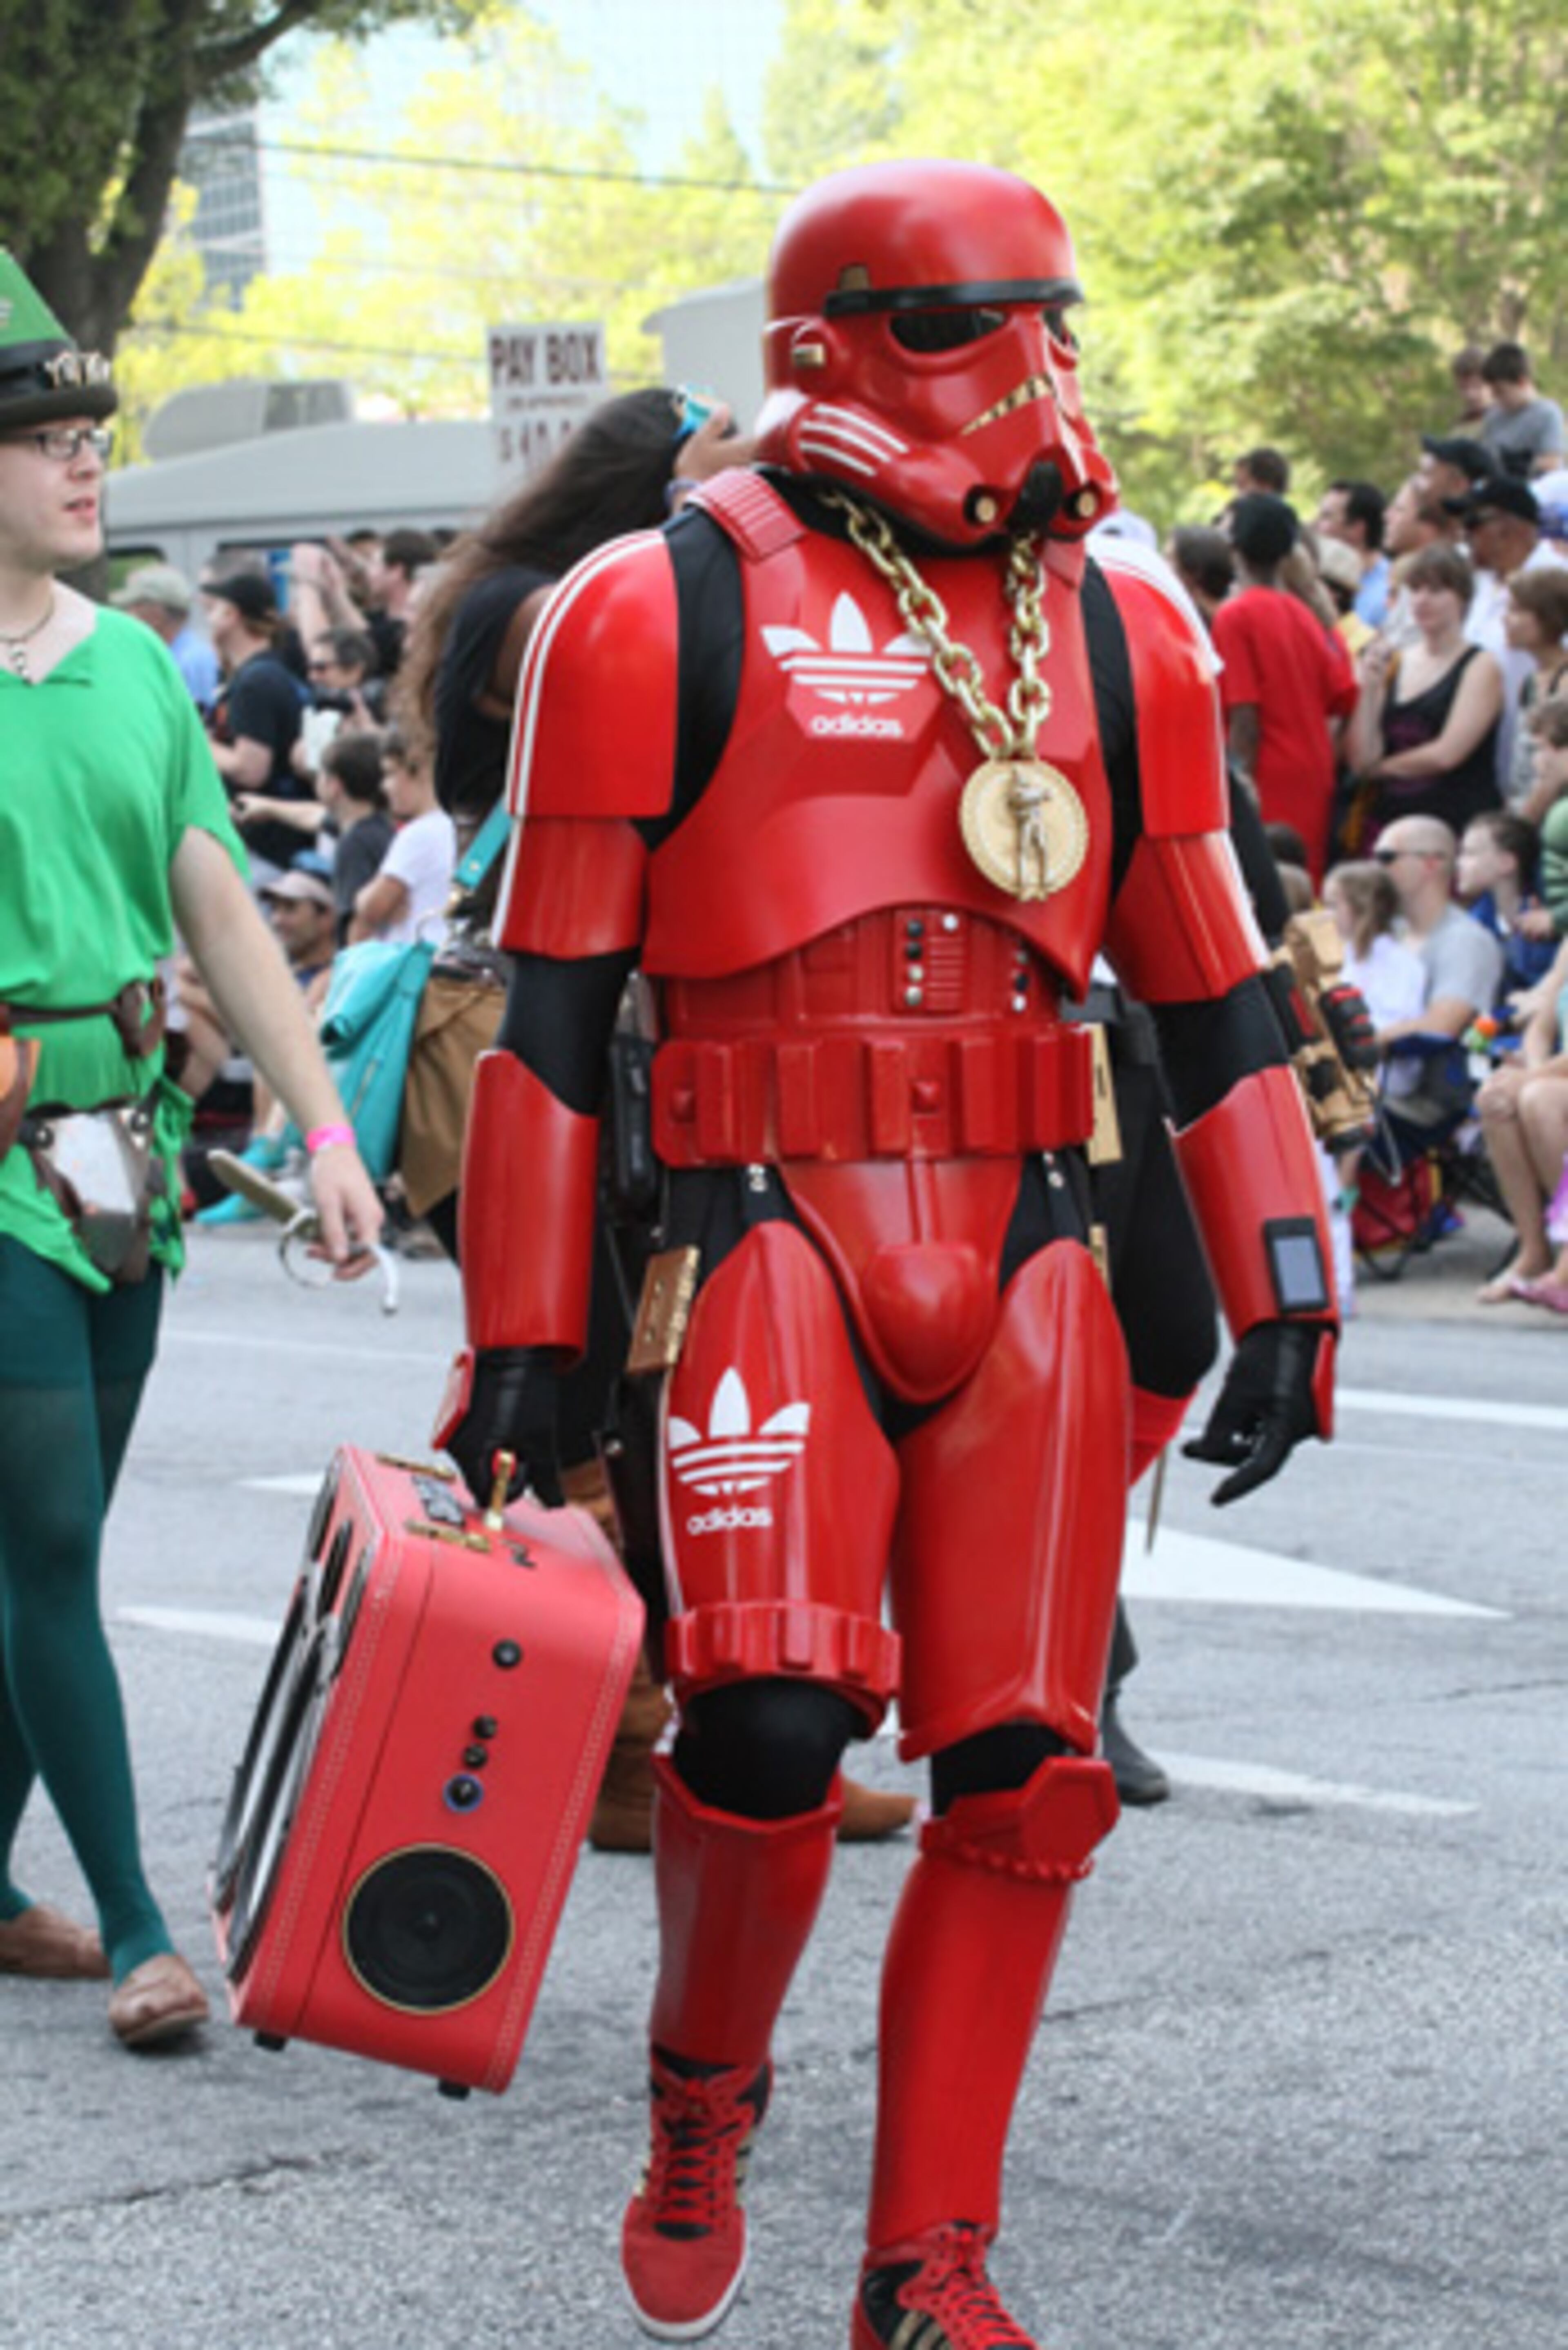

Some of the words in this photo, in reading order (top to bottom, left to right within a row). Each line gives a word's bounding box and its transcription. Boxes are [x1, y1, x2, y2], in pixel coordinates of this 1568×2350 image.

[490, 335, 535, 386] PAY
[547, 332, 600, 384] BOX
[811, 712, 904, 738] adidas
[686, 1504, 773, 1536] adidas
